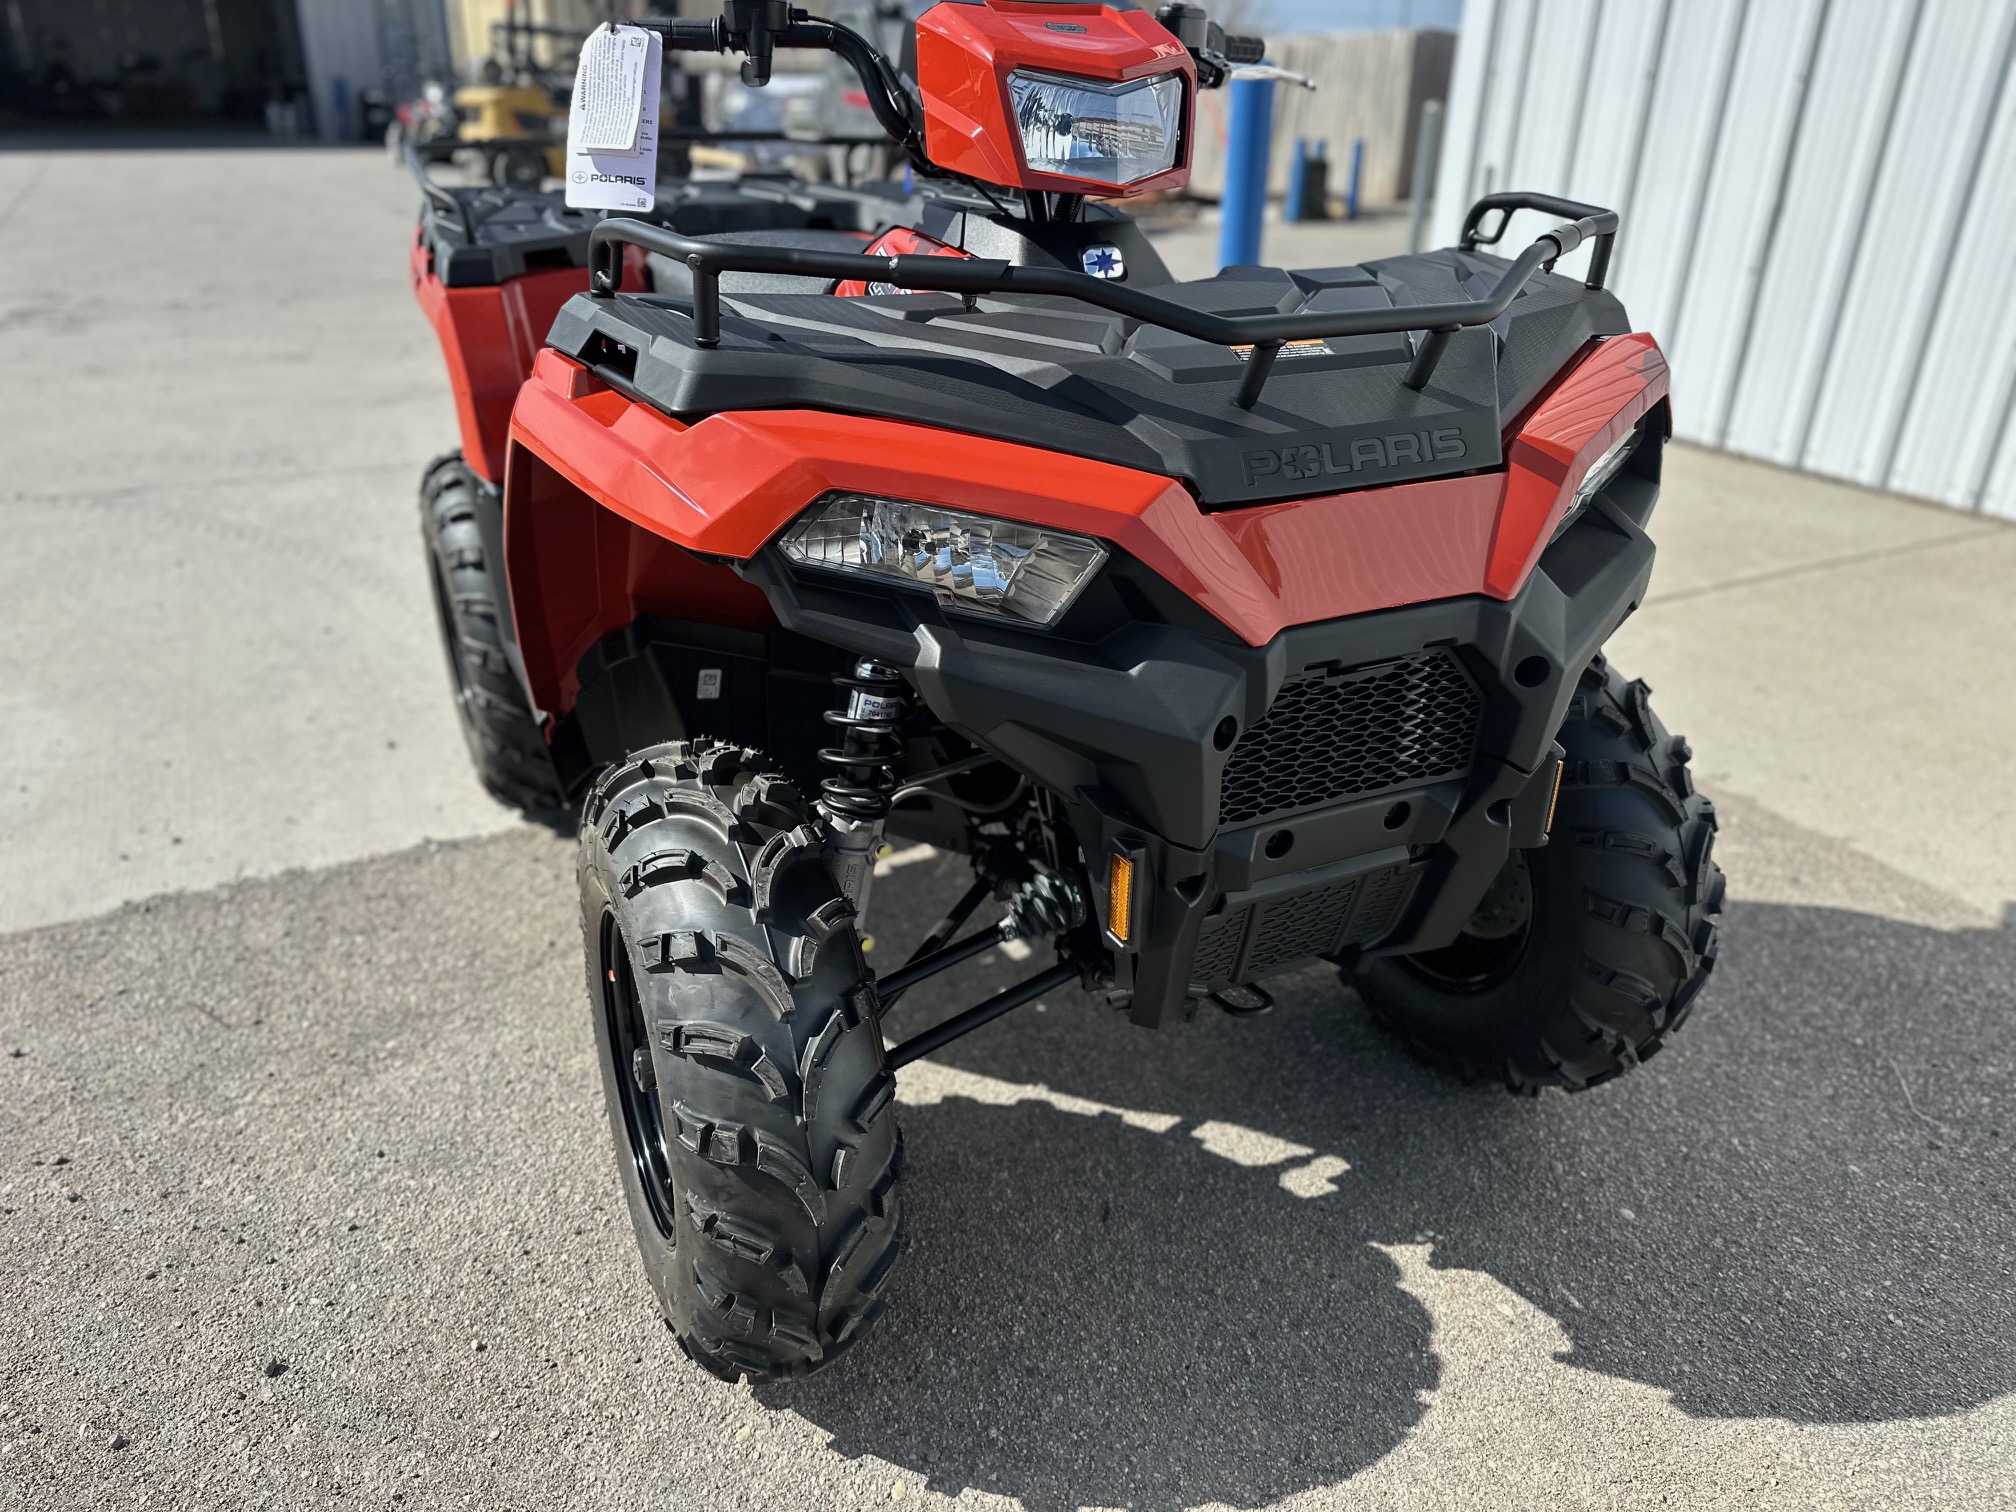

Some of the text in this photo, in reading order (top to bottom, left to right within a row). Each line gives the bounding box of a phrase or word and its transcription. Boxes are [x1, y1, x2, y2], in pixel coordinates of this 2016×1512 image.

[580, 64, 588, 103] WARNING
[591, 174, 646, 185] POLARIS
[1238, 427, 1467, 487] POLARIS
